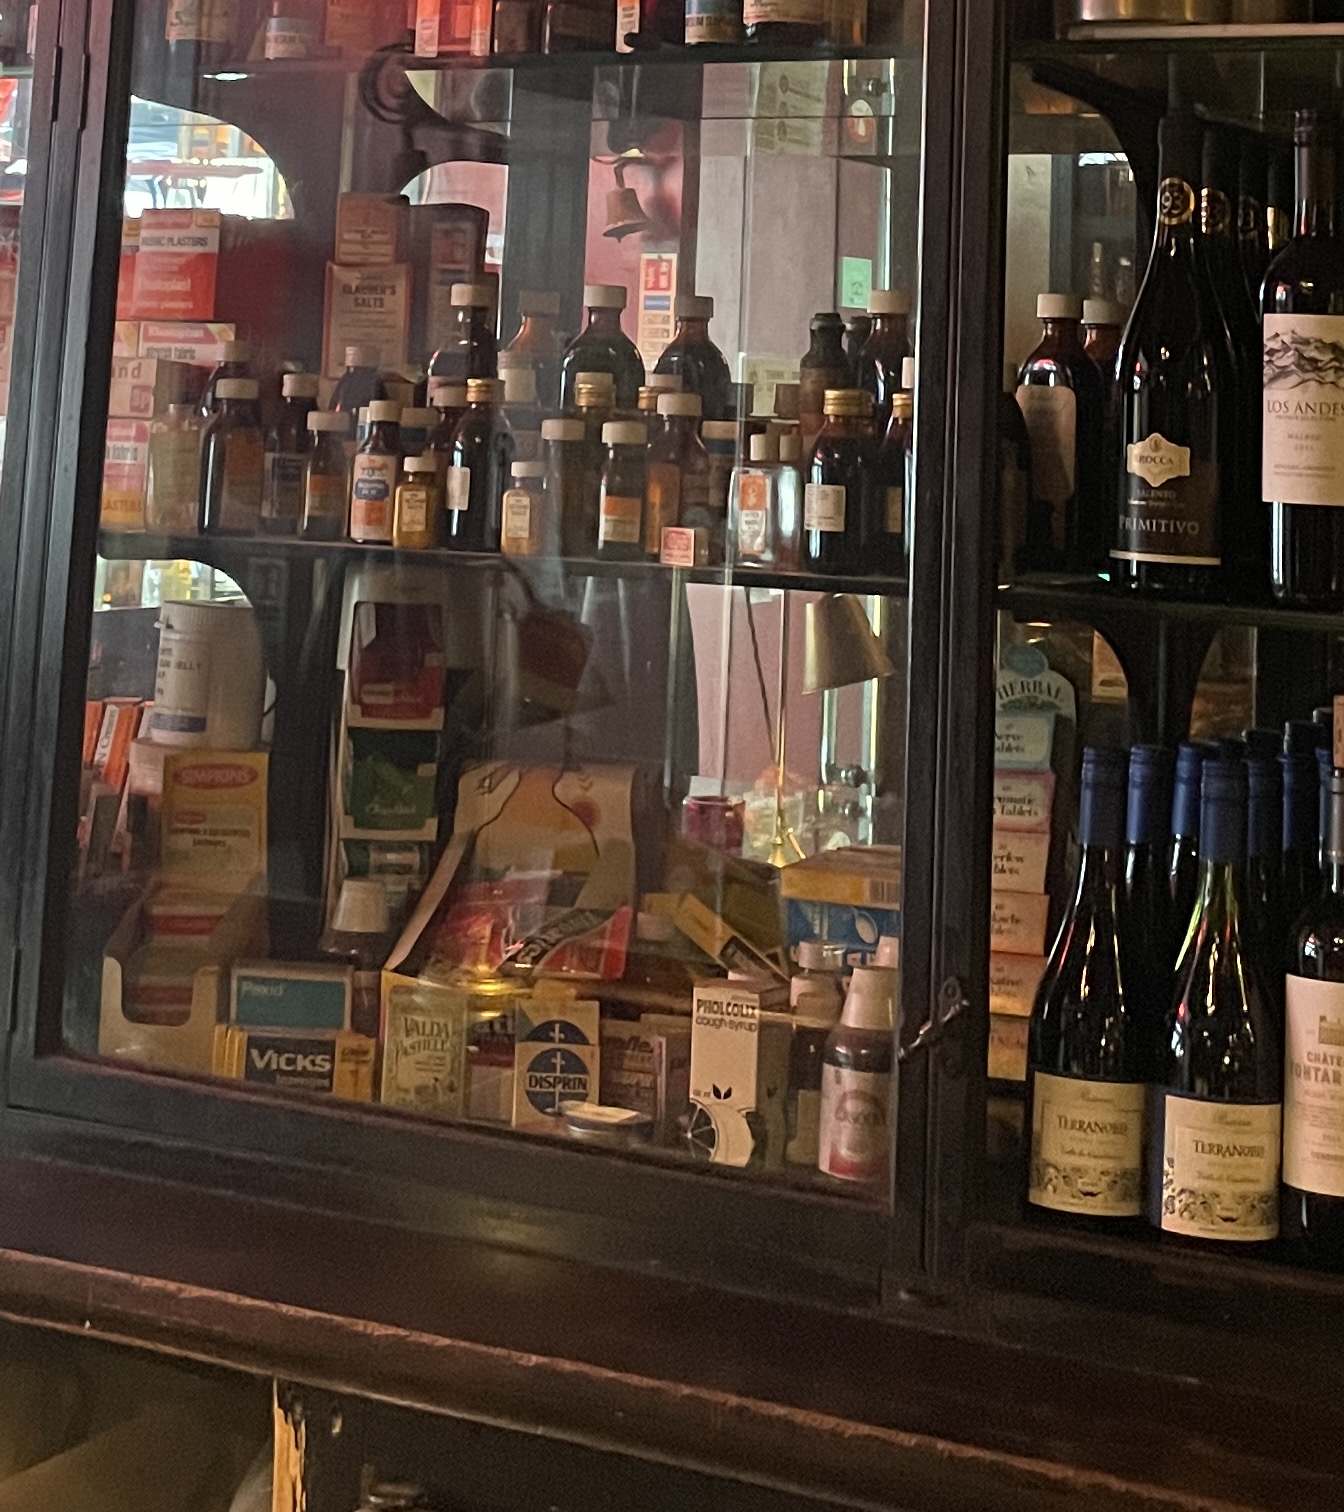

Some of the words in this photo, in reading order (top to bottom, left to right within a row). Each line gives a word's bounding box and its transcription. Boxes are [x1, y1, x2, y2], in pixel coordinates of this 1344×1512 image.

[1160, 190, 1183, 214] 93
[353, 297, 384, 309] SALTS
[1267, 400, 1291, 415] LOS
[1118, 515, 1200, 536] PRIMITIVO
[403, 1017, 452, 1041] VALDA
[695, 1016, 726, 1029] cough
[728, 1020, 758, 1034] syrup
[249, 1048, 333, 1075] VICKS
[527, 1072, 589, 1093] DISPRIN
